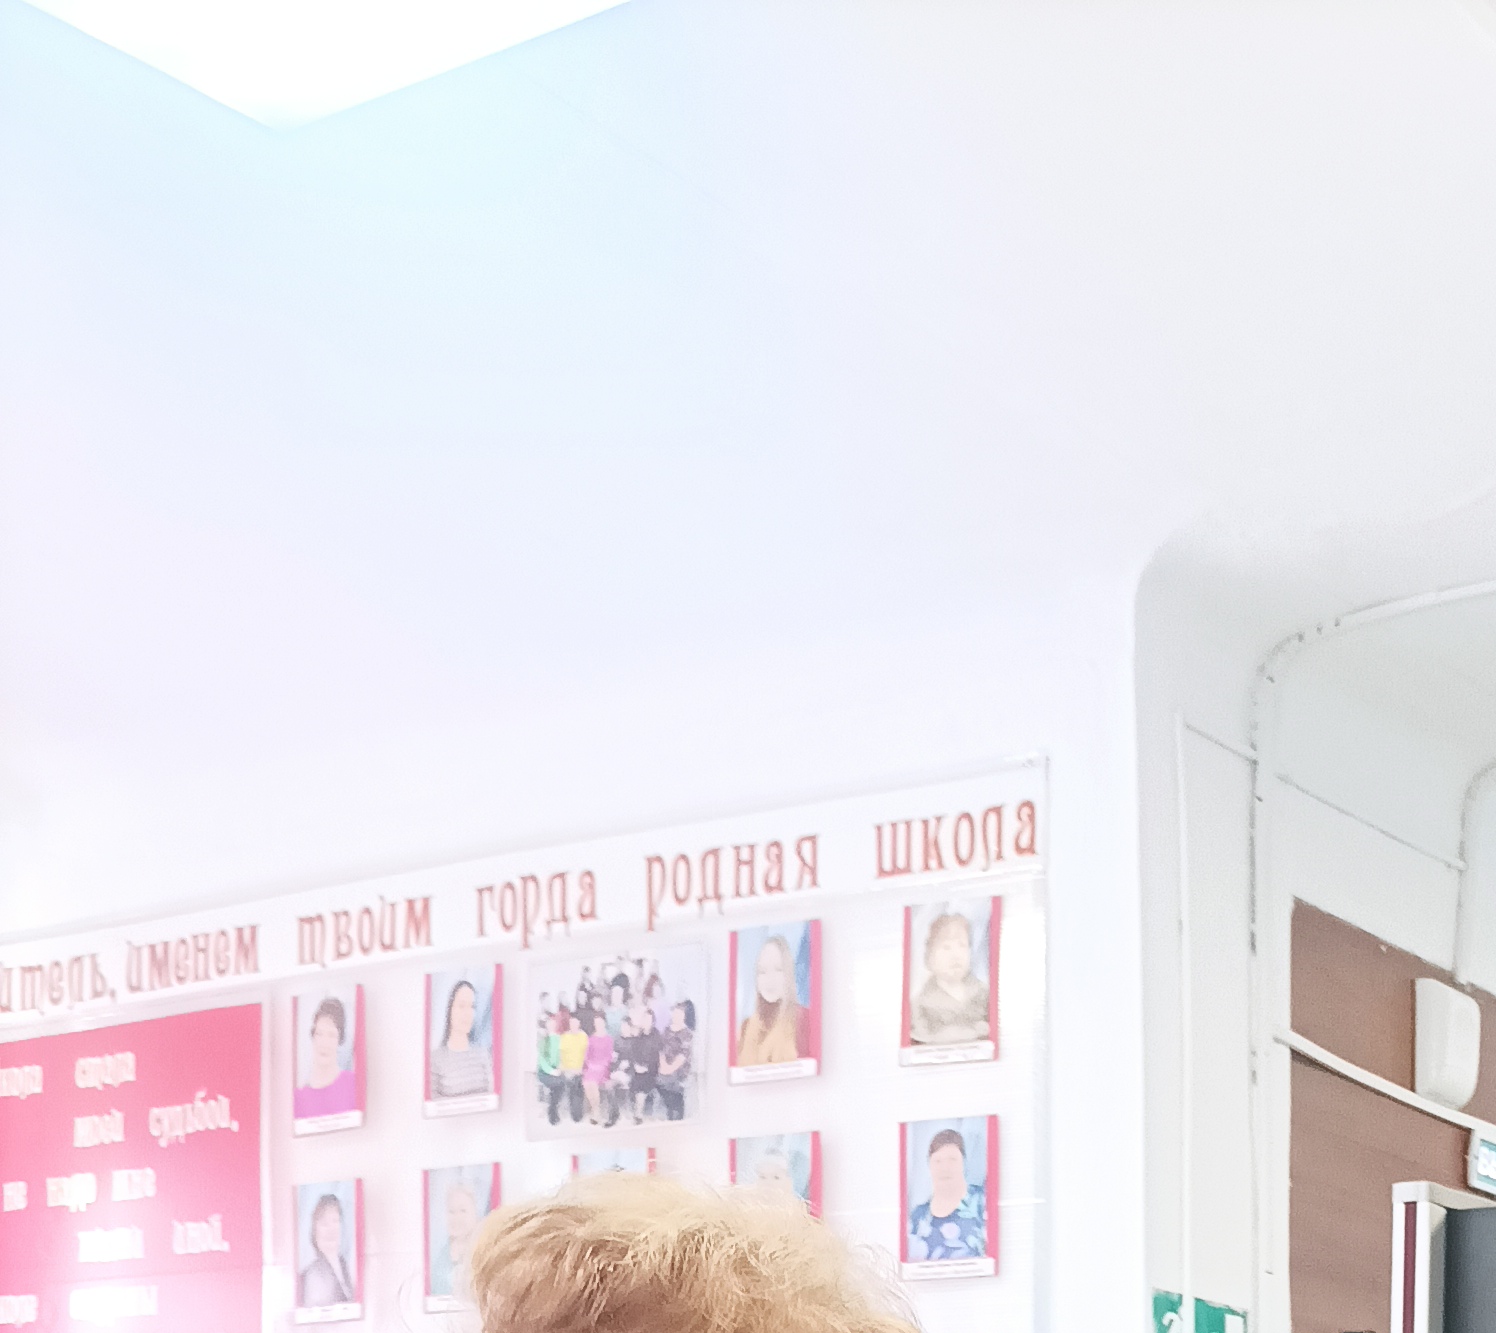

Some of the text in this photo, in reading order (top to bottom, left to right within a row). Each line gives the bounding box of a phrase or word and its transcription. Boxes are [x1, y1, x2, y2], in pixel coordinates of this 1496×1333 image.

[126, 924, 260, 993] именем
[297, 895, 433, 968] твоим
[475, 869, 598, 950] горда
[645, 834, 821, 931] родная
[874, 799, 1039, 879] школа
